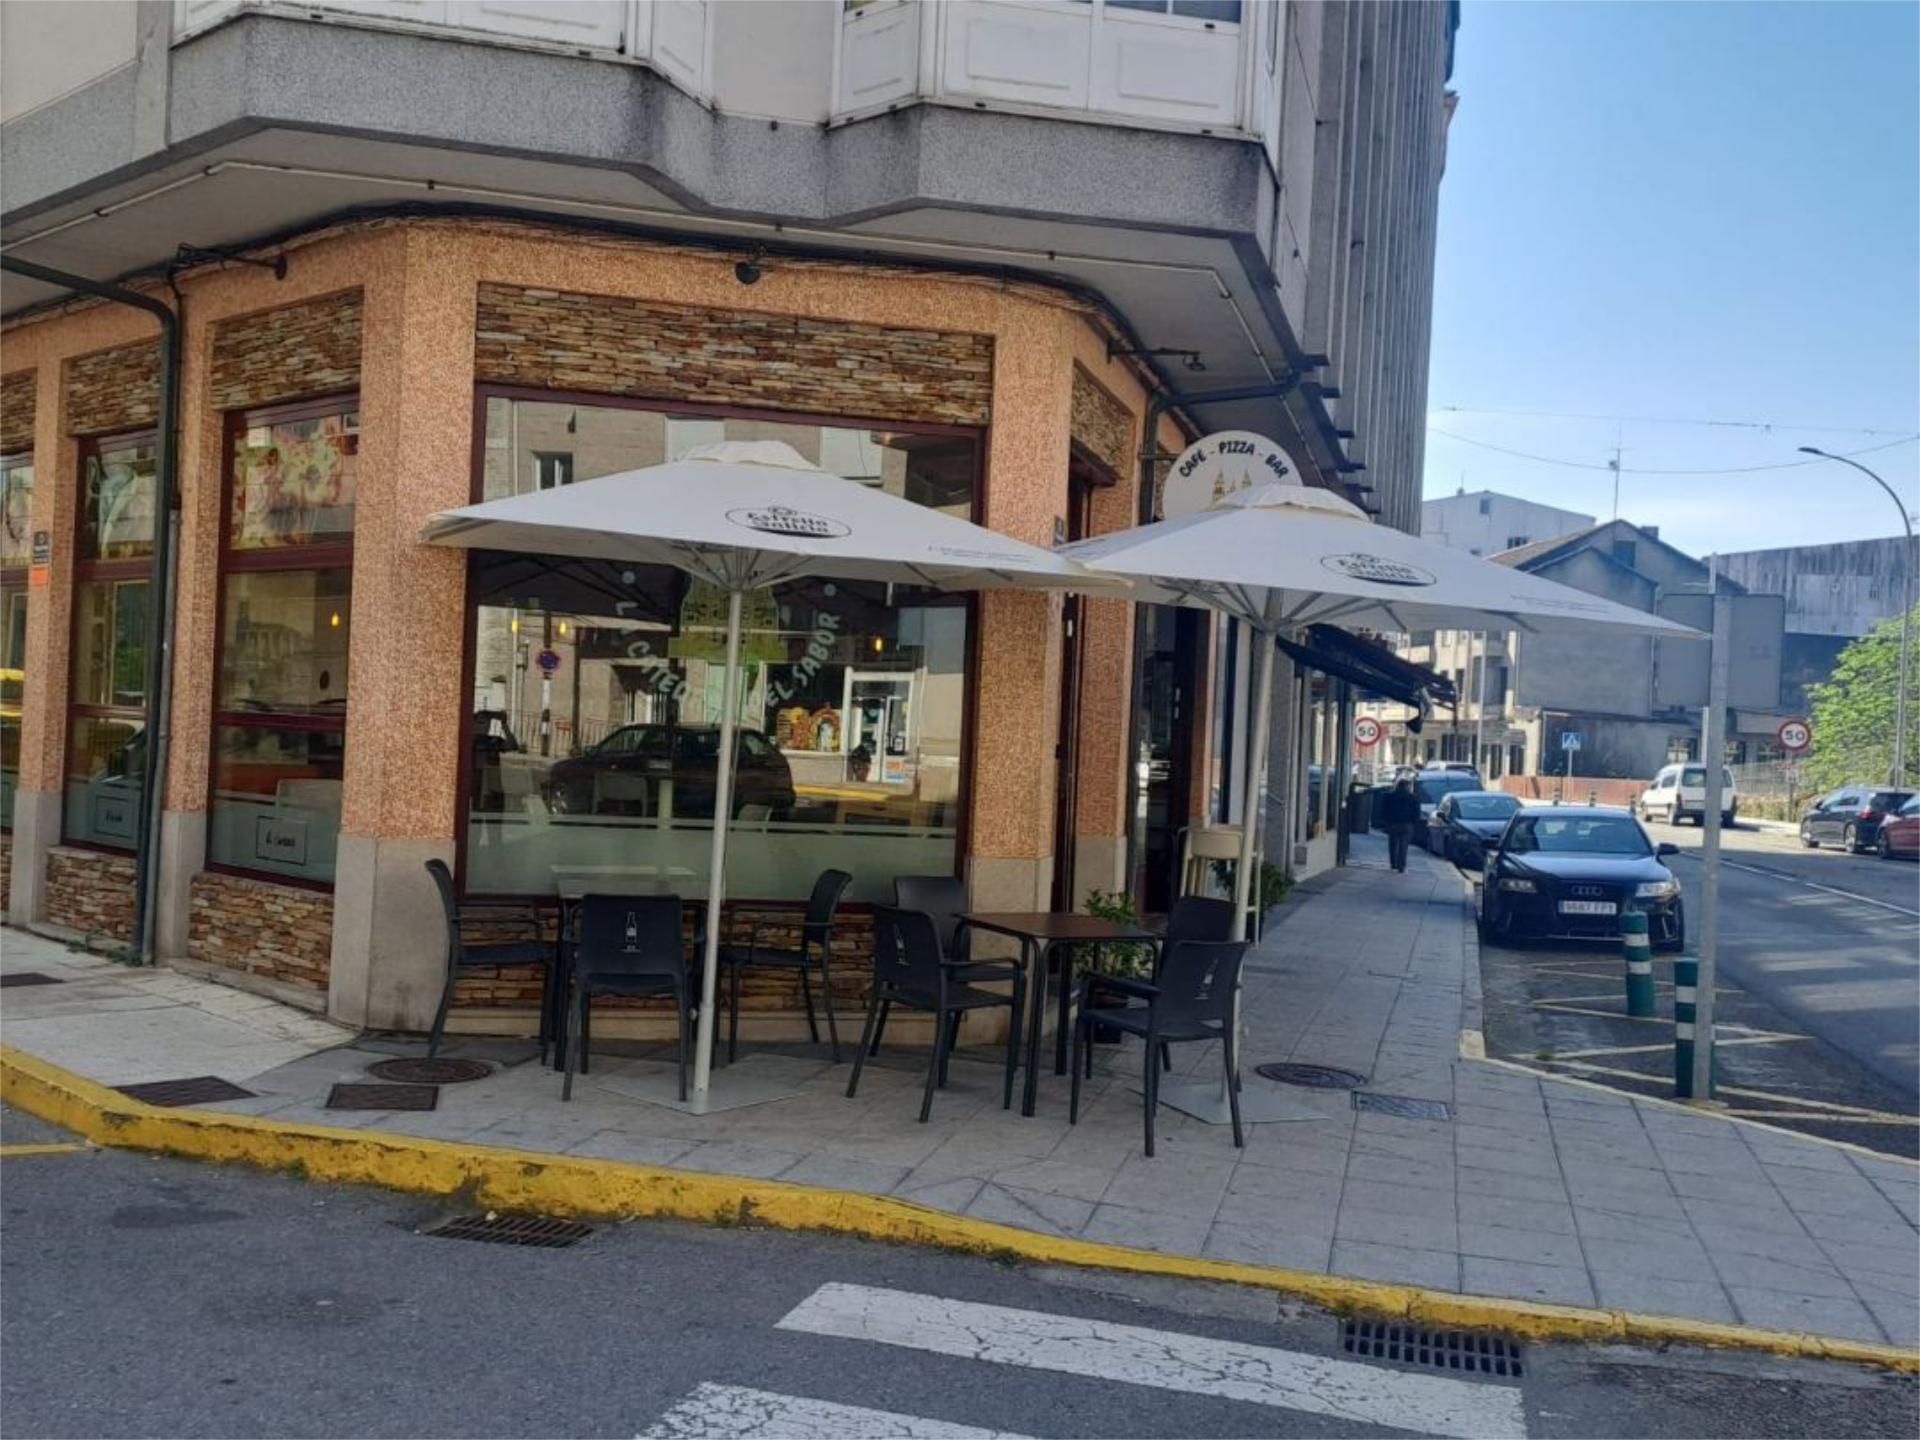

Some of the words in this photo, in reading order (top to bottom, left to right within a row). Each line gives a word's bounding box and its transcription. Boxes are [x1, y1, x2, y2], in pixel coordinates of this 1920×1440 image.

[1179, 450, 1206, 477] CAFE
[1218, 441, 1256, 456] PIZZA
[1265, 454, 1289, 479] BAR
[792, 612, 841, 687] SABOR
[1358, 726, 1376, 737] 50
[1785, 730, 1806, 741] 50
